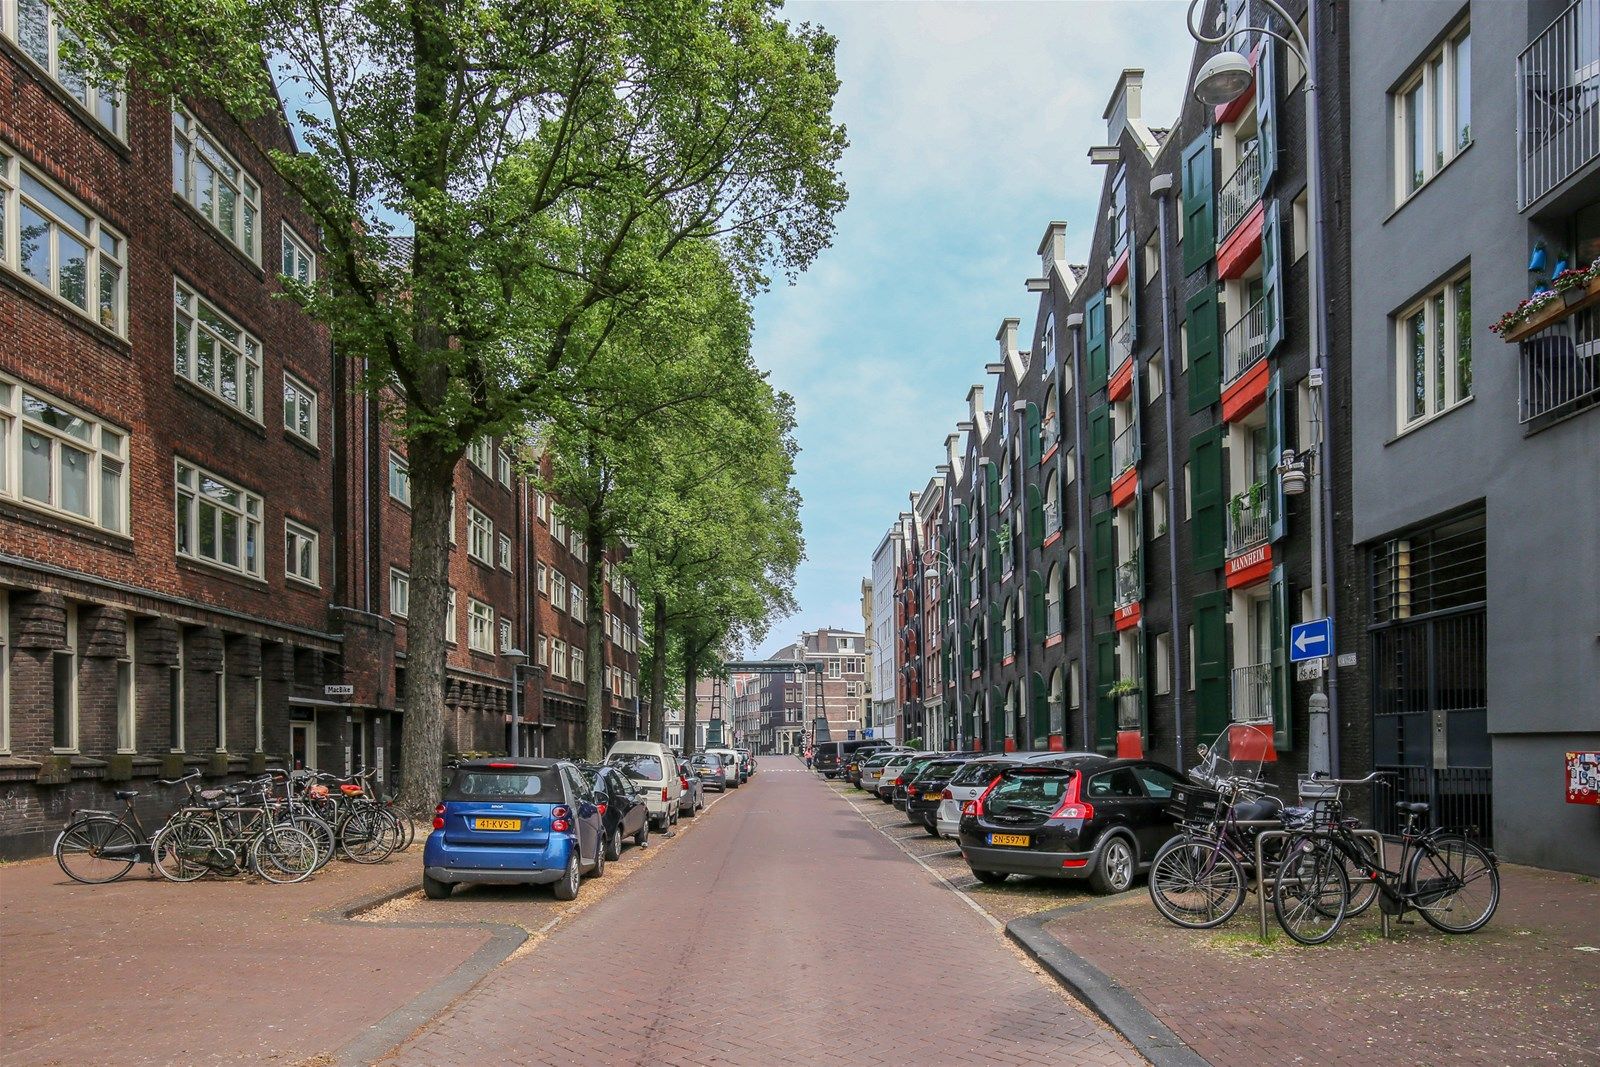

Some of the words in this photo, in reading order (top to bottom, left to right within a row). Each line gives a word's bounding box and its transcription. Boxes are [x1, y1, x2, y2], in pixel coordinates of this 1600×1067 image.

[1231, 547, 1265, 573] MANNHEIM
[327, 686, 351, 694] MacBike
[480, 820, 516, 829] 41-KVS-1
[993, 835, 1027, 845] SN-597-V
